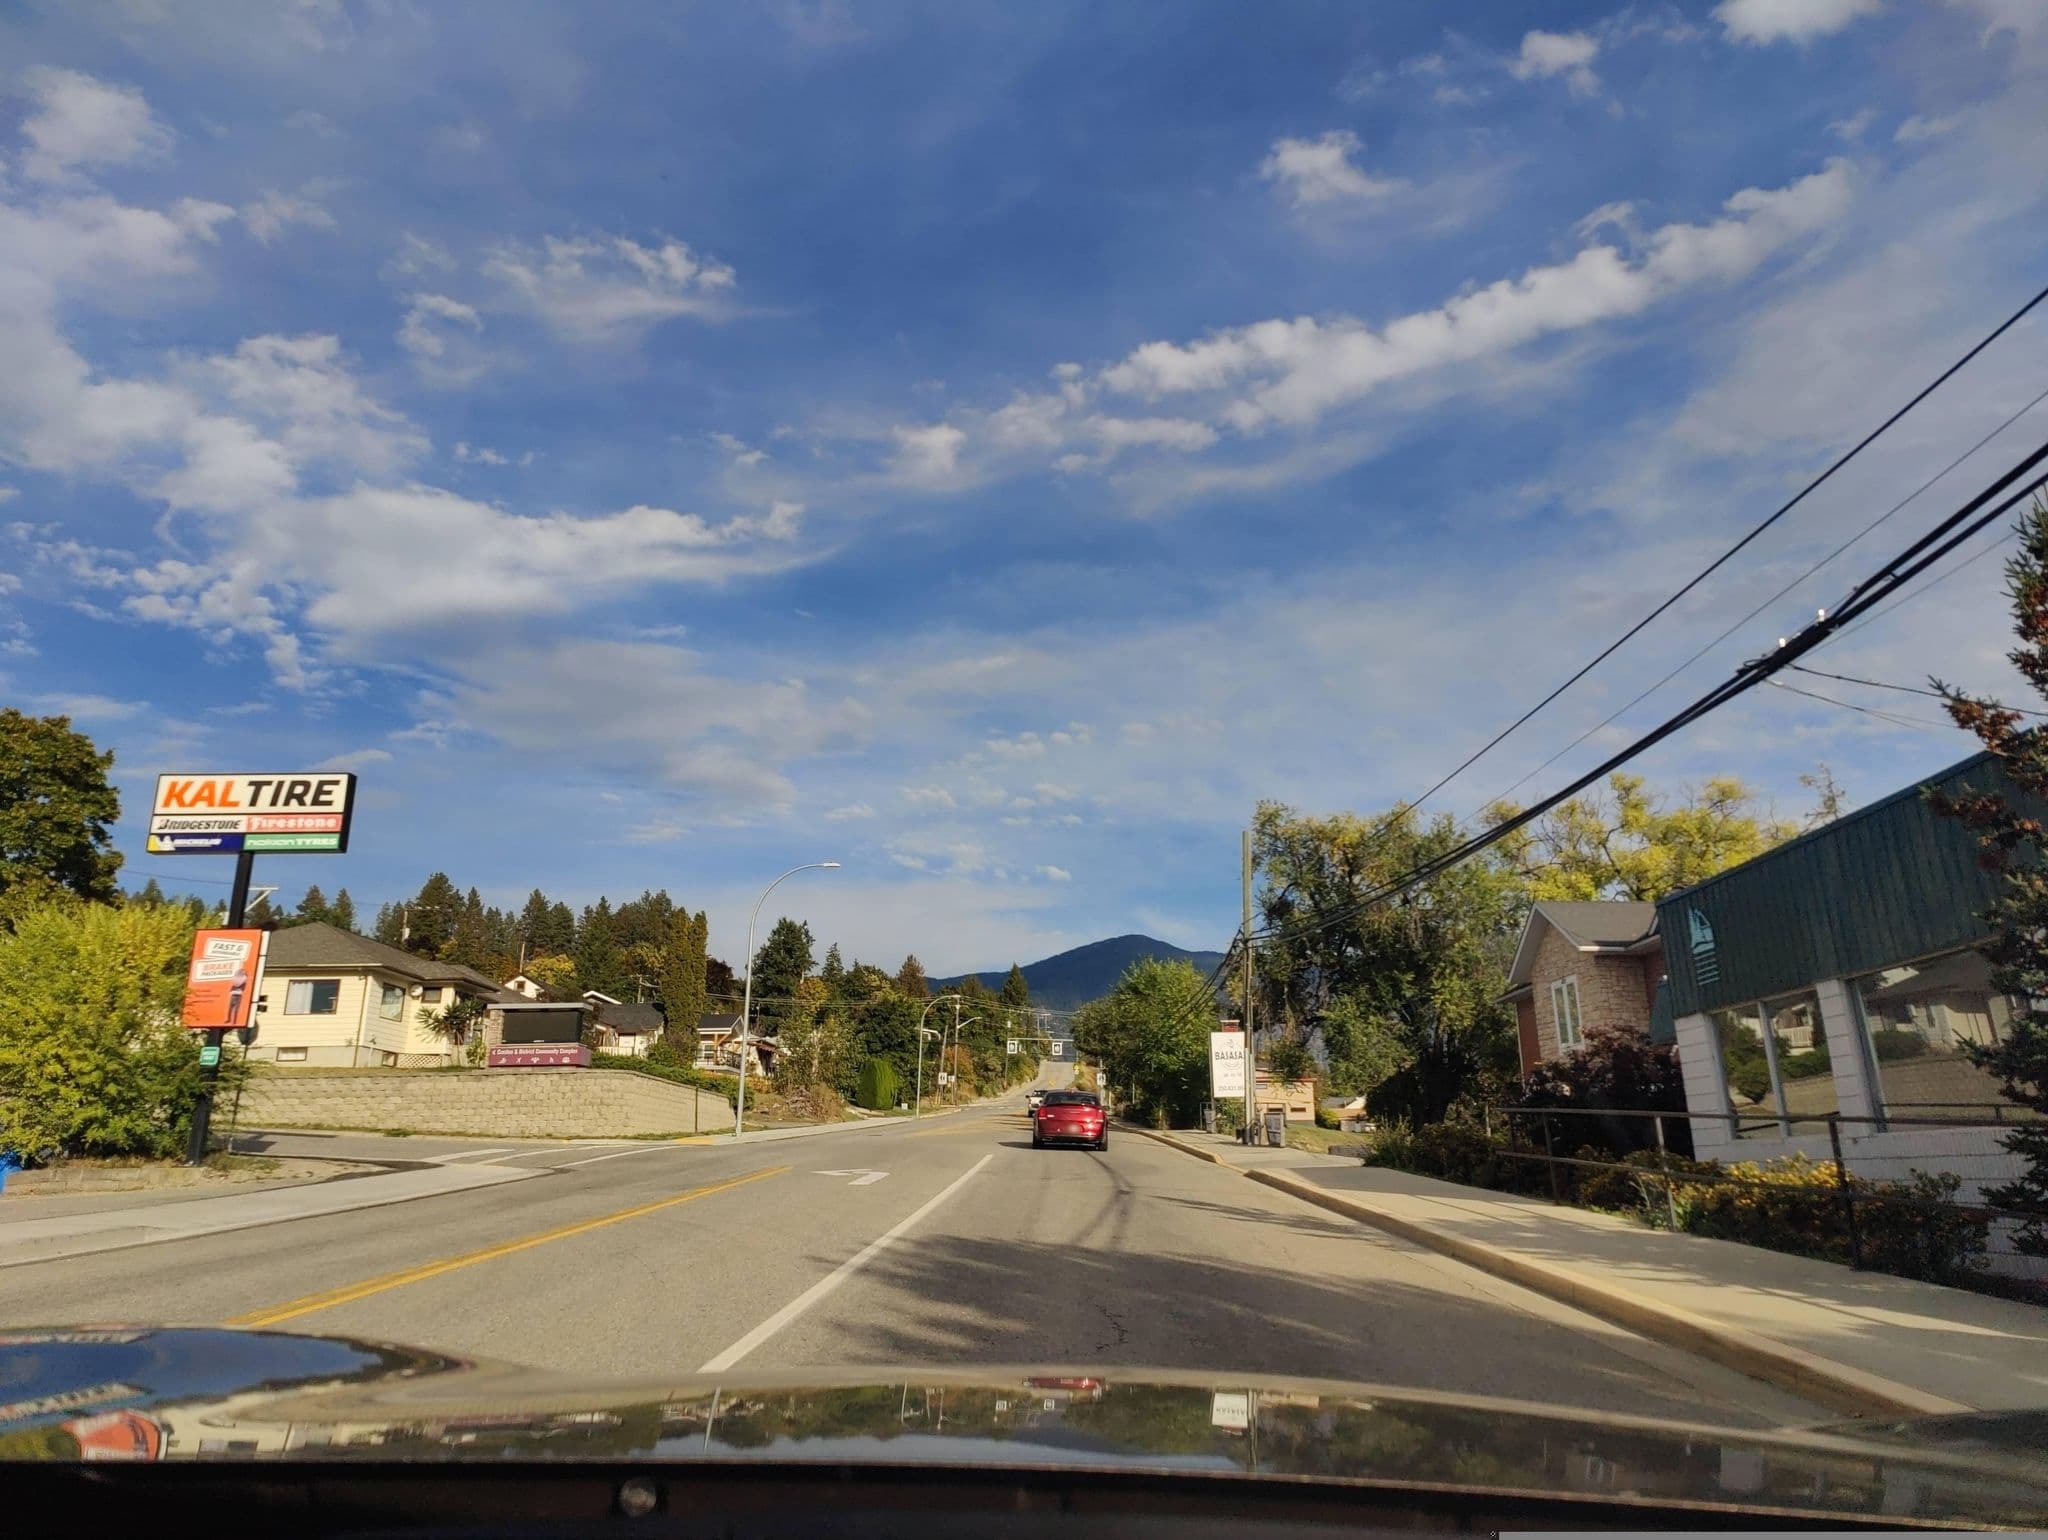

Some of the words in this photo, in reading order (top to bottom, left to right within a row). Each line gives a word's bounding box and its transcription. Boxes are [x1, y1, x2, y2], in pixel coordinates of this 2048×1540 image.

[162, 780, 240, 808] KAL
[248, 779, 340, 807] TIRE
[158, 819, 242, 830] BRIDGESTONE
[252, 816, 337, 829] Firestone
[213, 943, 236, 951] FAST
